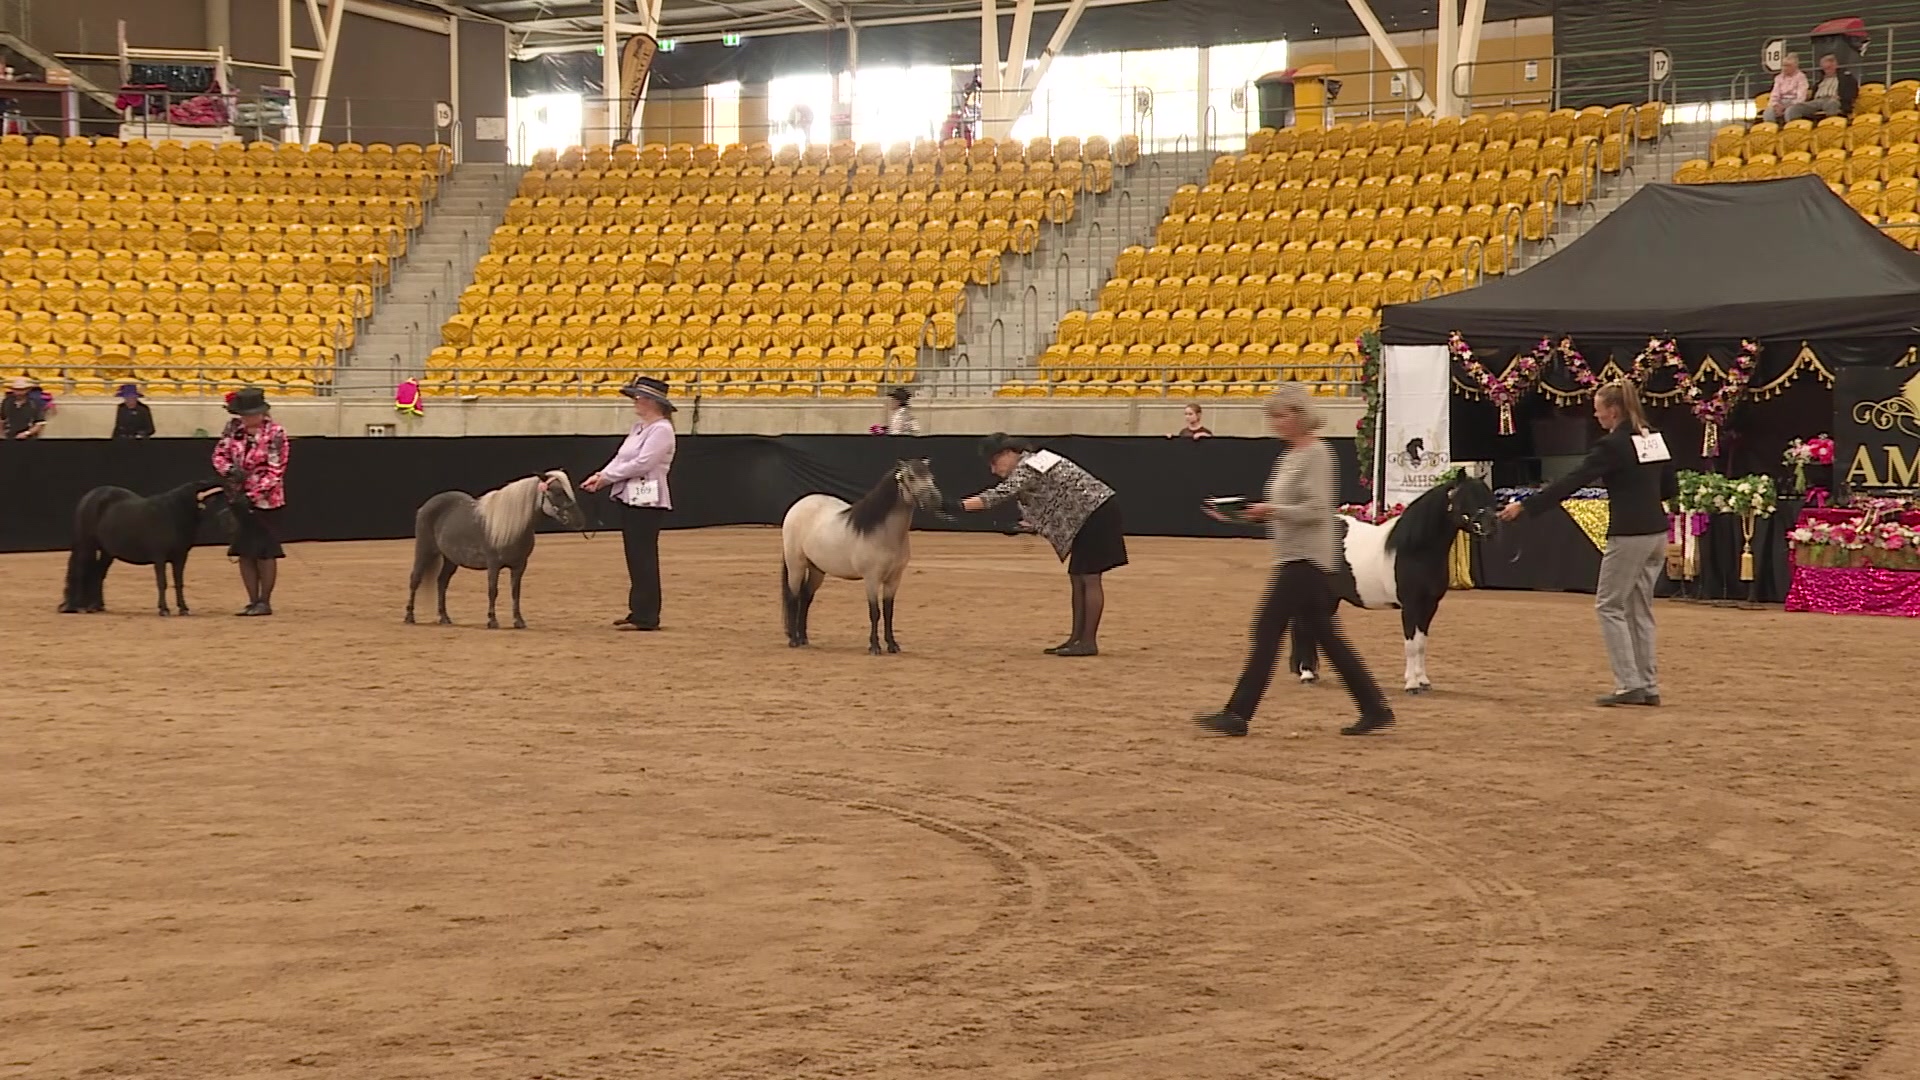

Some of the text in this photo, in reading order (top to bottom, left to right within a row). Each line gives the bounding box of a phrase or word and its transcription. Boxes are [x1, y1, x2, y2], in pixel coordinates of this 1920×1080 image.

[1767, 51, 1780, 61] 18
[1656, 60, 1666, 71] 17
[439, 110, 449, 119] 15
